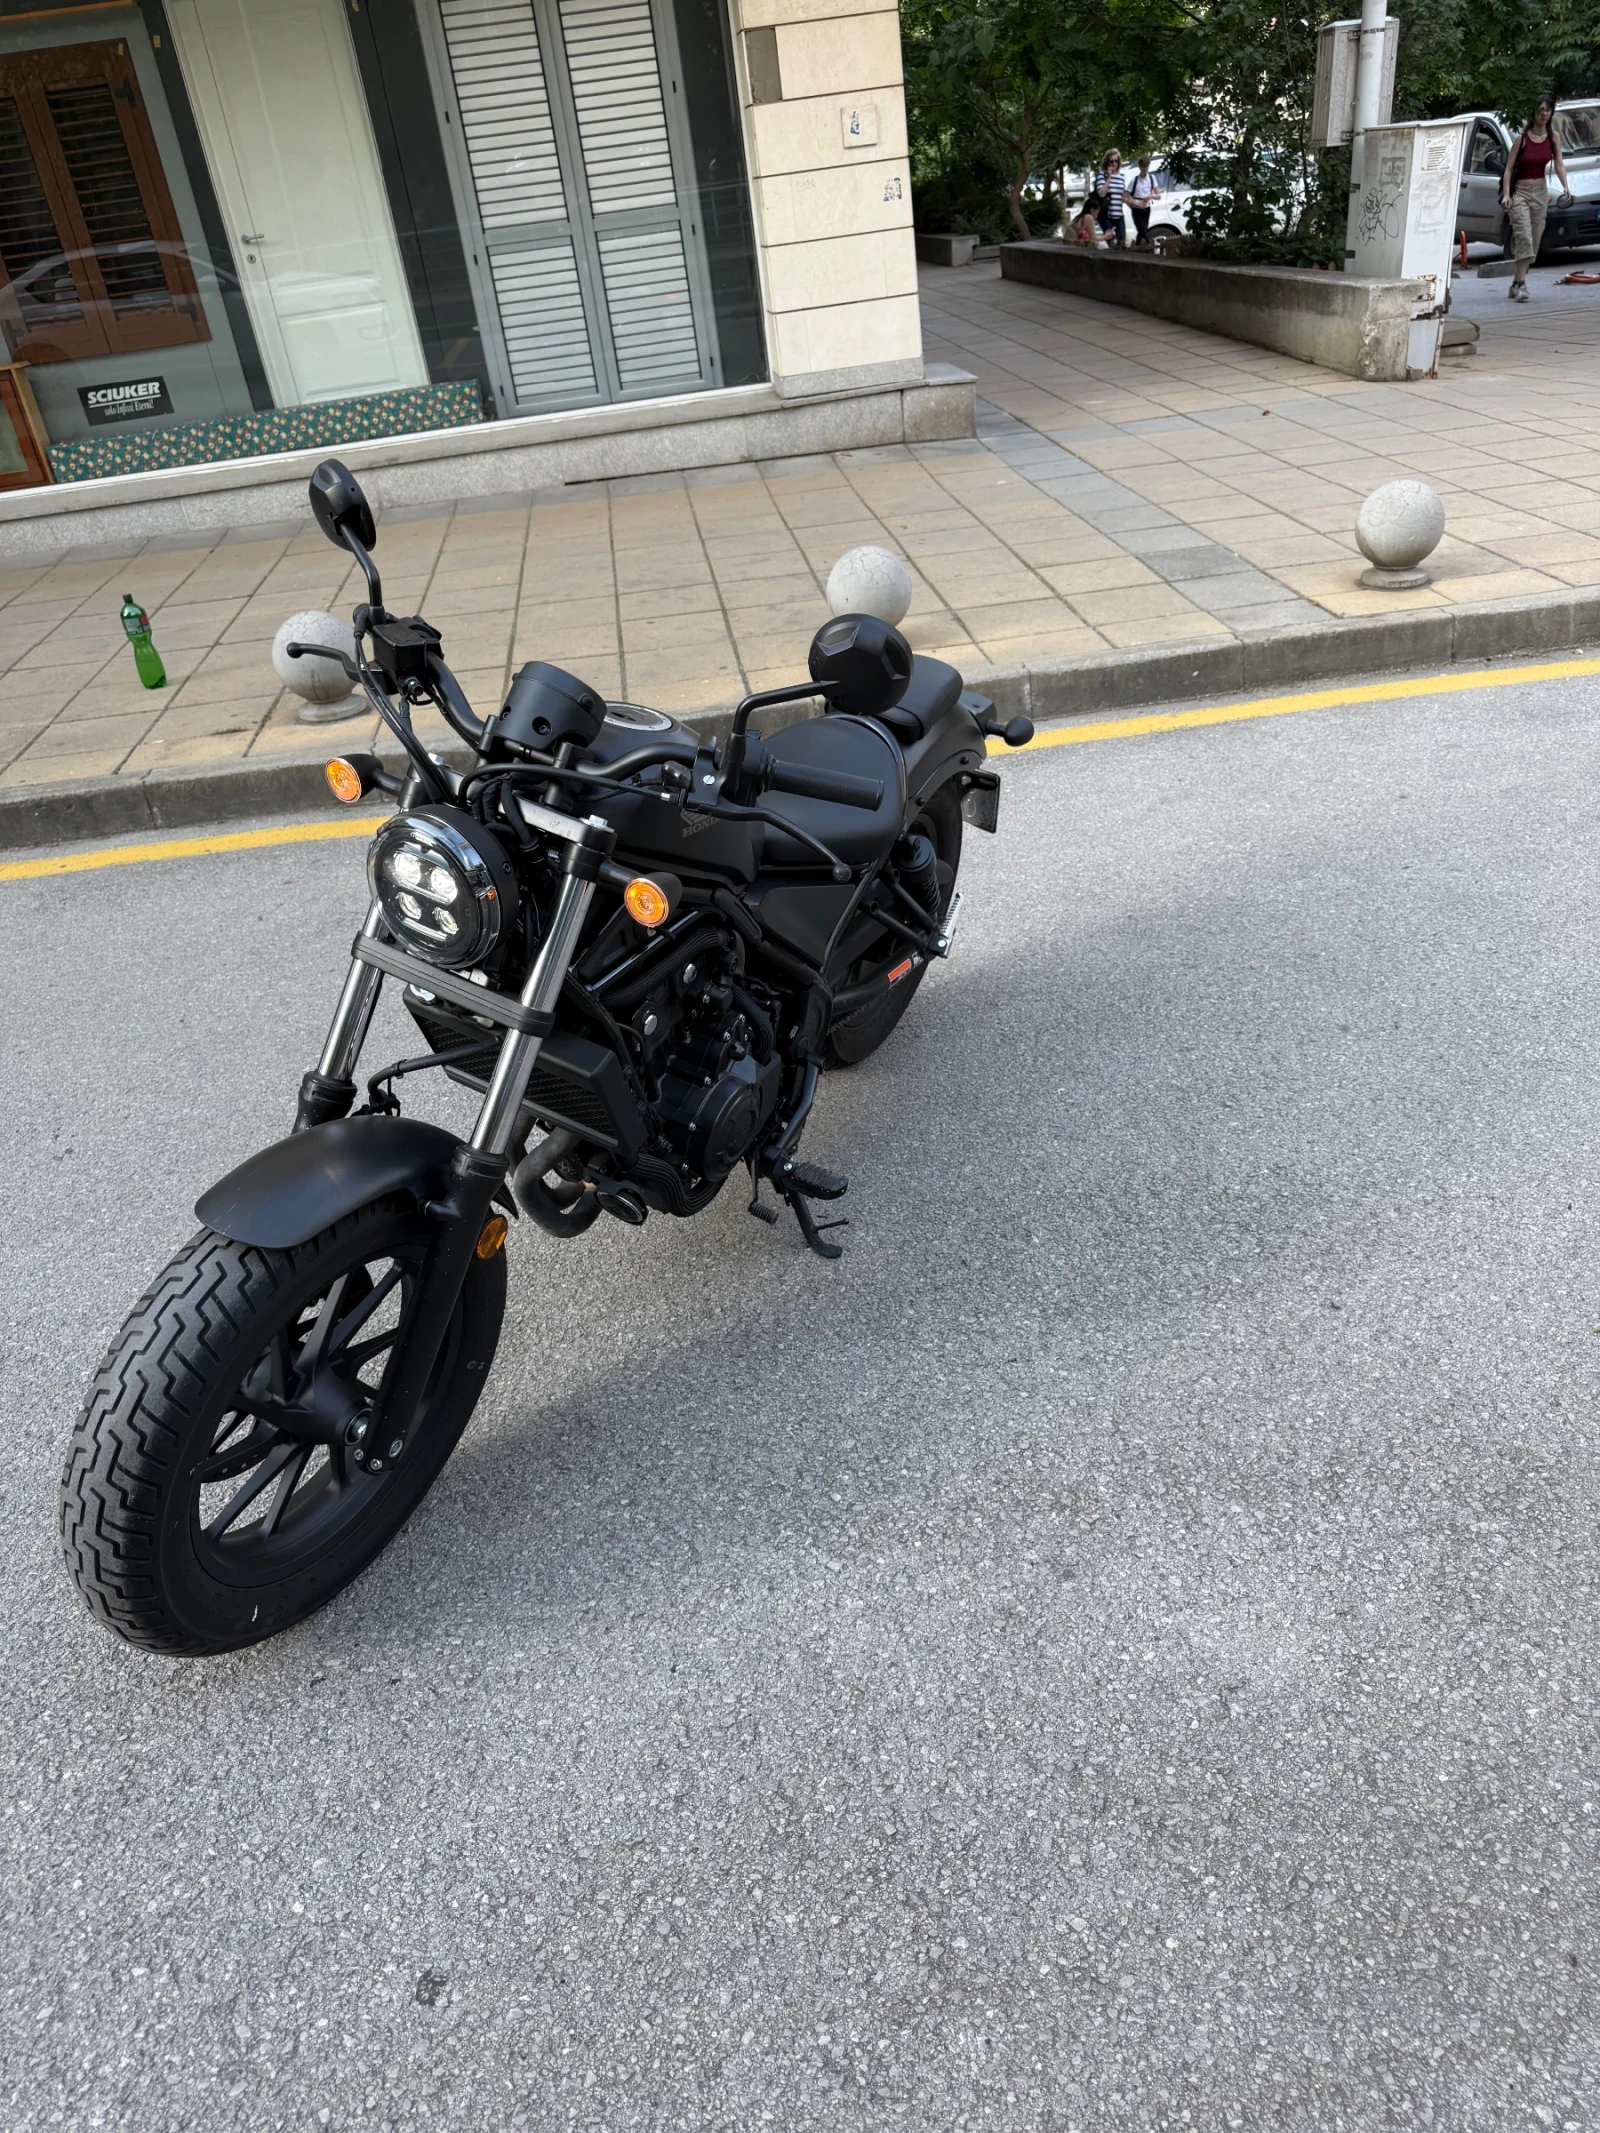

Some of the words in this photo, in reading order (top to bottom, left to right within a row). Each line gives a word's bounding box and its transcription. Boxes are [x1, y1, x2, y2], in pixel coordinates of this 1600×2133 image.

[87, 382, 160, 404] SCIUKER
[104, 405, 117, 416] solo
[682, 816, 720, 838] HOND
